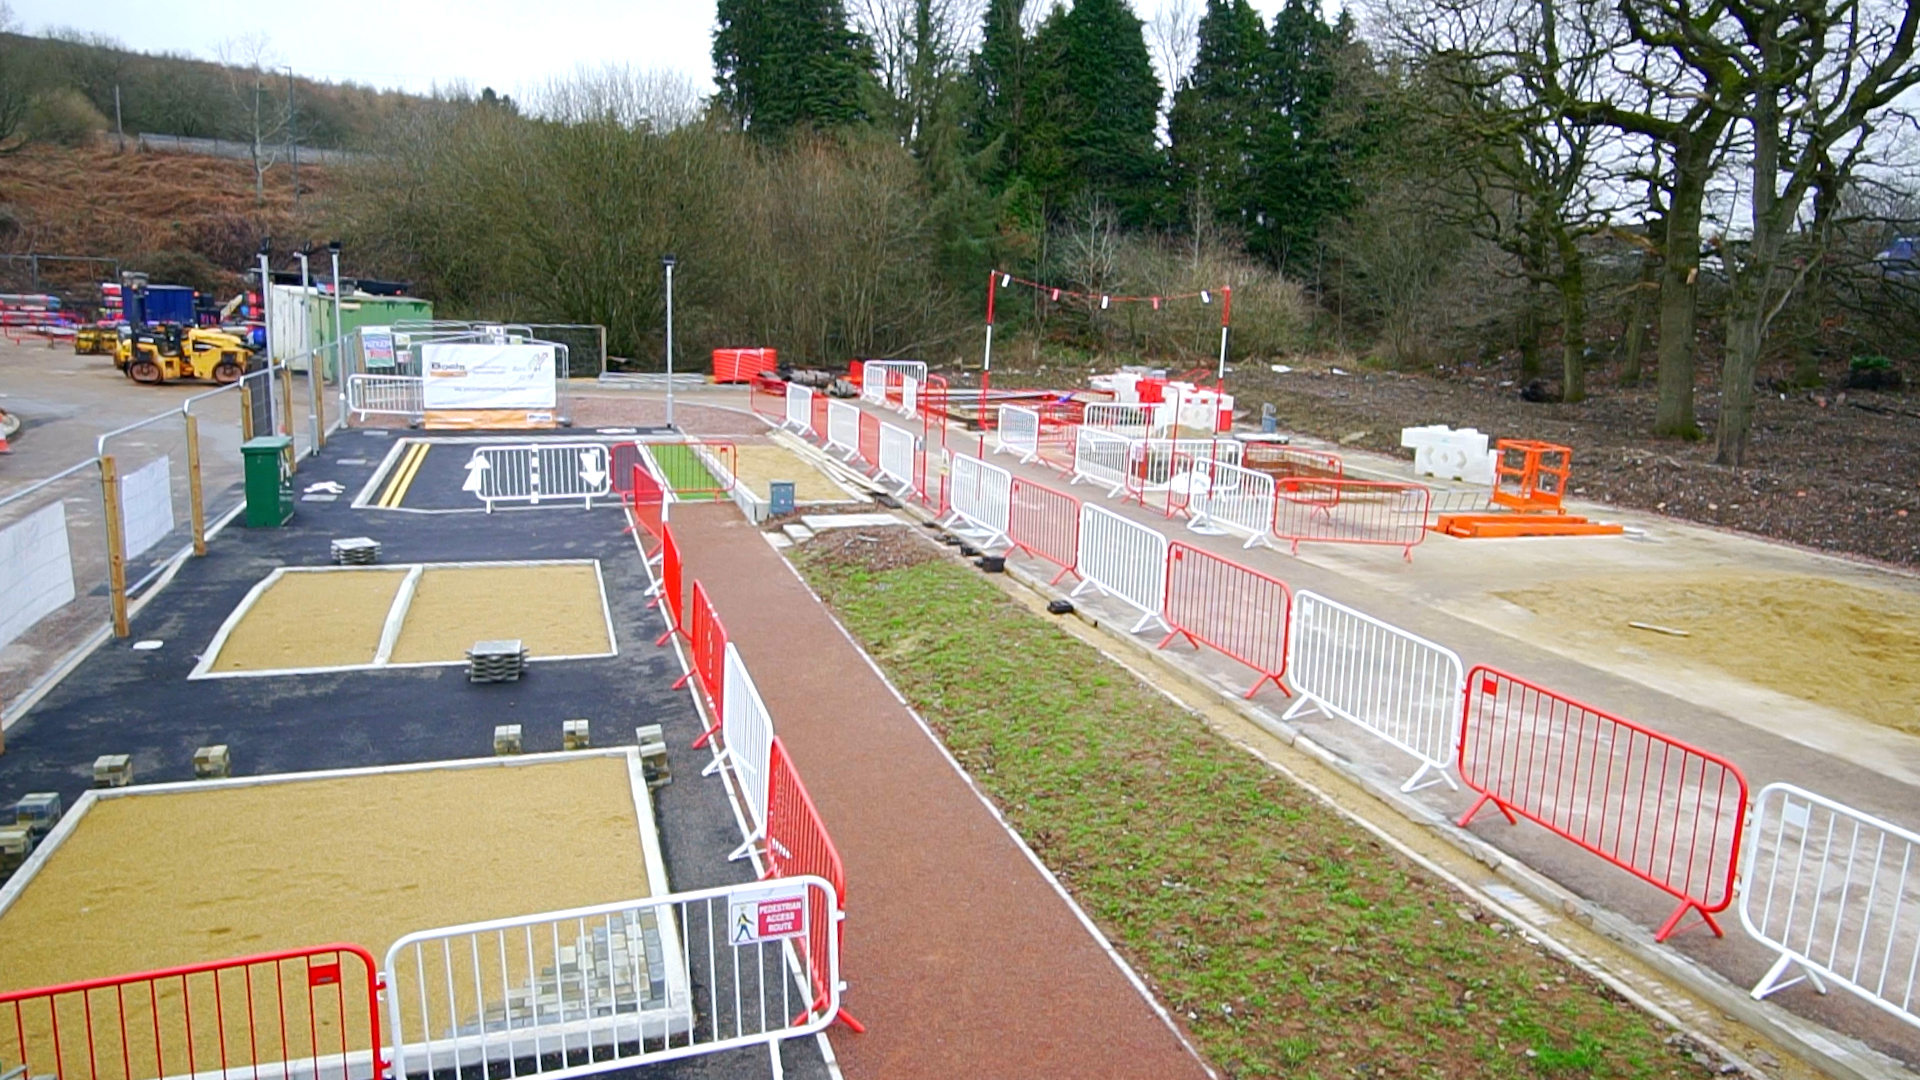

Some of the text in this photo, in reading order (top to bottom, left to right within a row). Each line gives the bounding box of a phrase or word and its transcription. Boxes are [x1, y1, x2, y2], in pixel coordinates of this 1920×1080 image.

[759, 901, 801, 914] PEDESTRIAN
[766, 911, 795, 923] ACCESS
[768, 921, 793, 932] ROUTE
